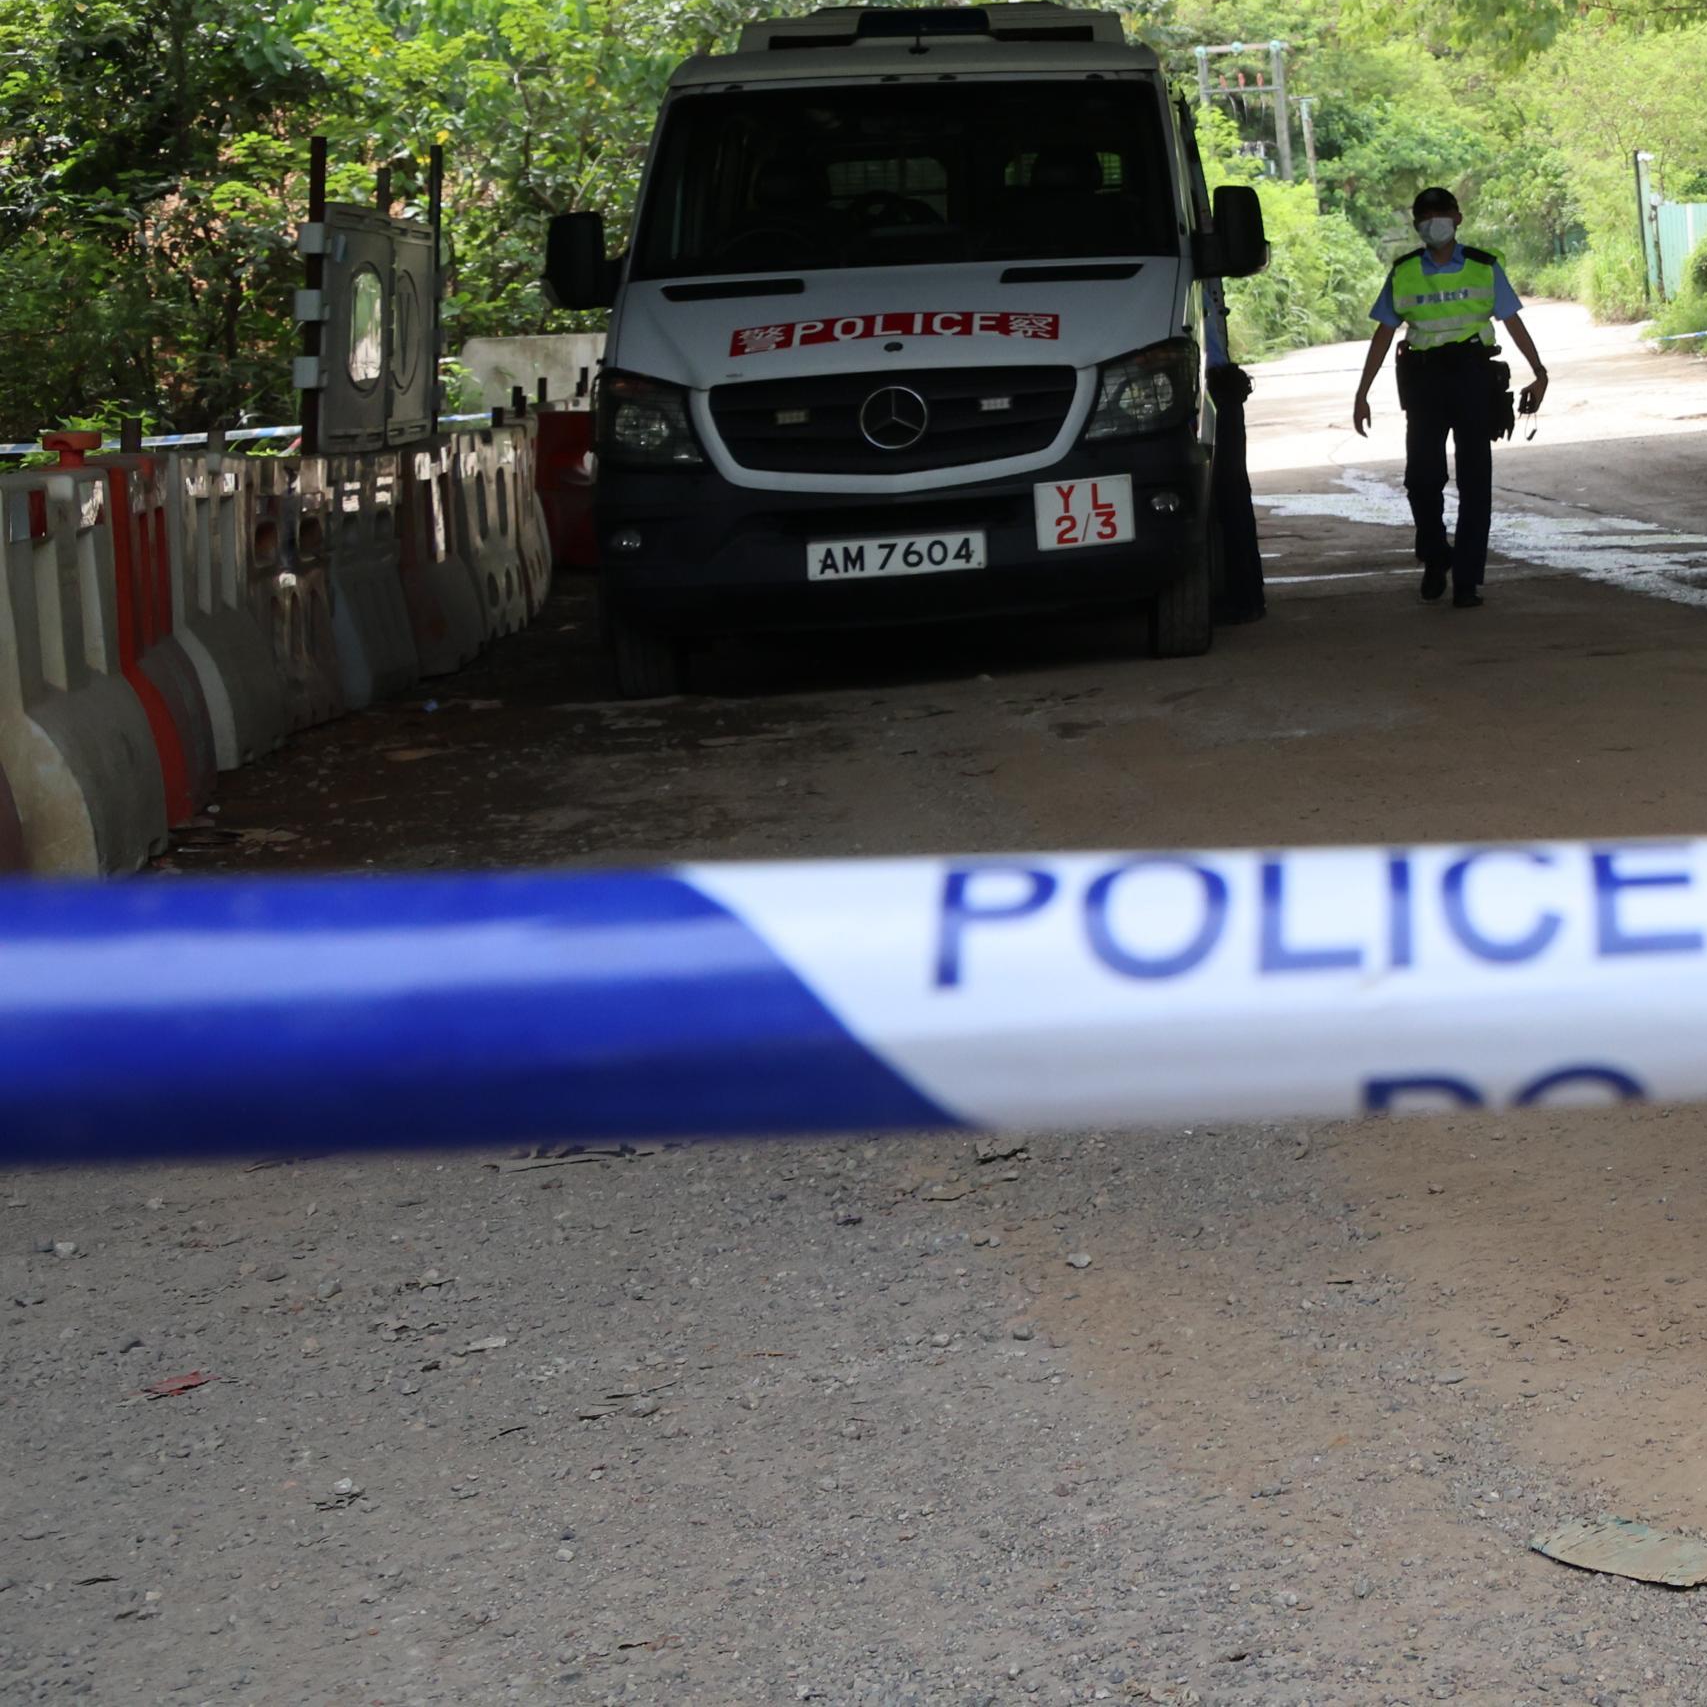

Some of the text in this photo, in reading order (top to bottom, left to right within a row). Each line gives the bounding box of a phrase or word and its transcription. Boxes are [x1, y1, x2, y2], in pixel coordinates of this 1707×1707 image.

[791, 313, 1001, 347] POLICE
[1009, 314, 1055, 339] 察
[1055, 509, 1118, 545] 2/3
[819, 538, 973, 575] AM 7604
